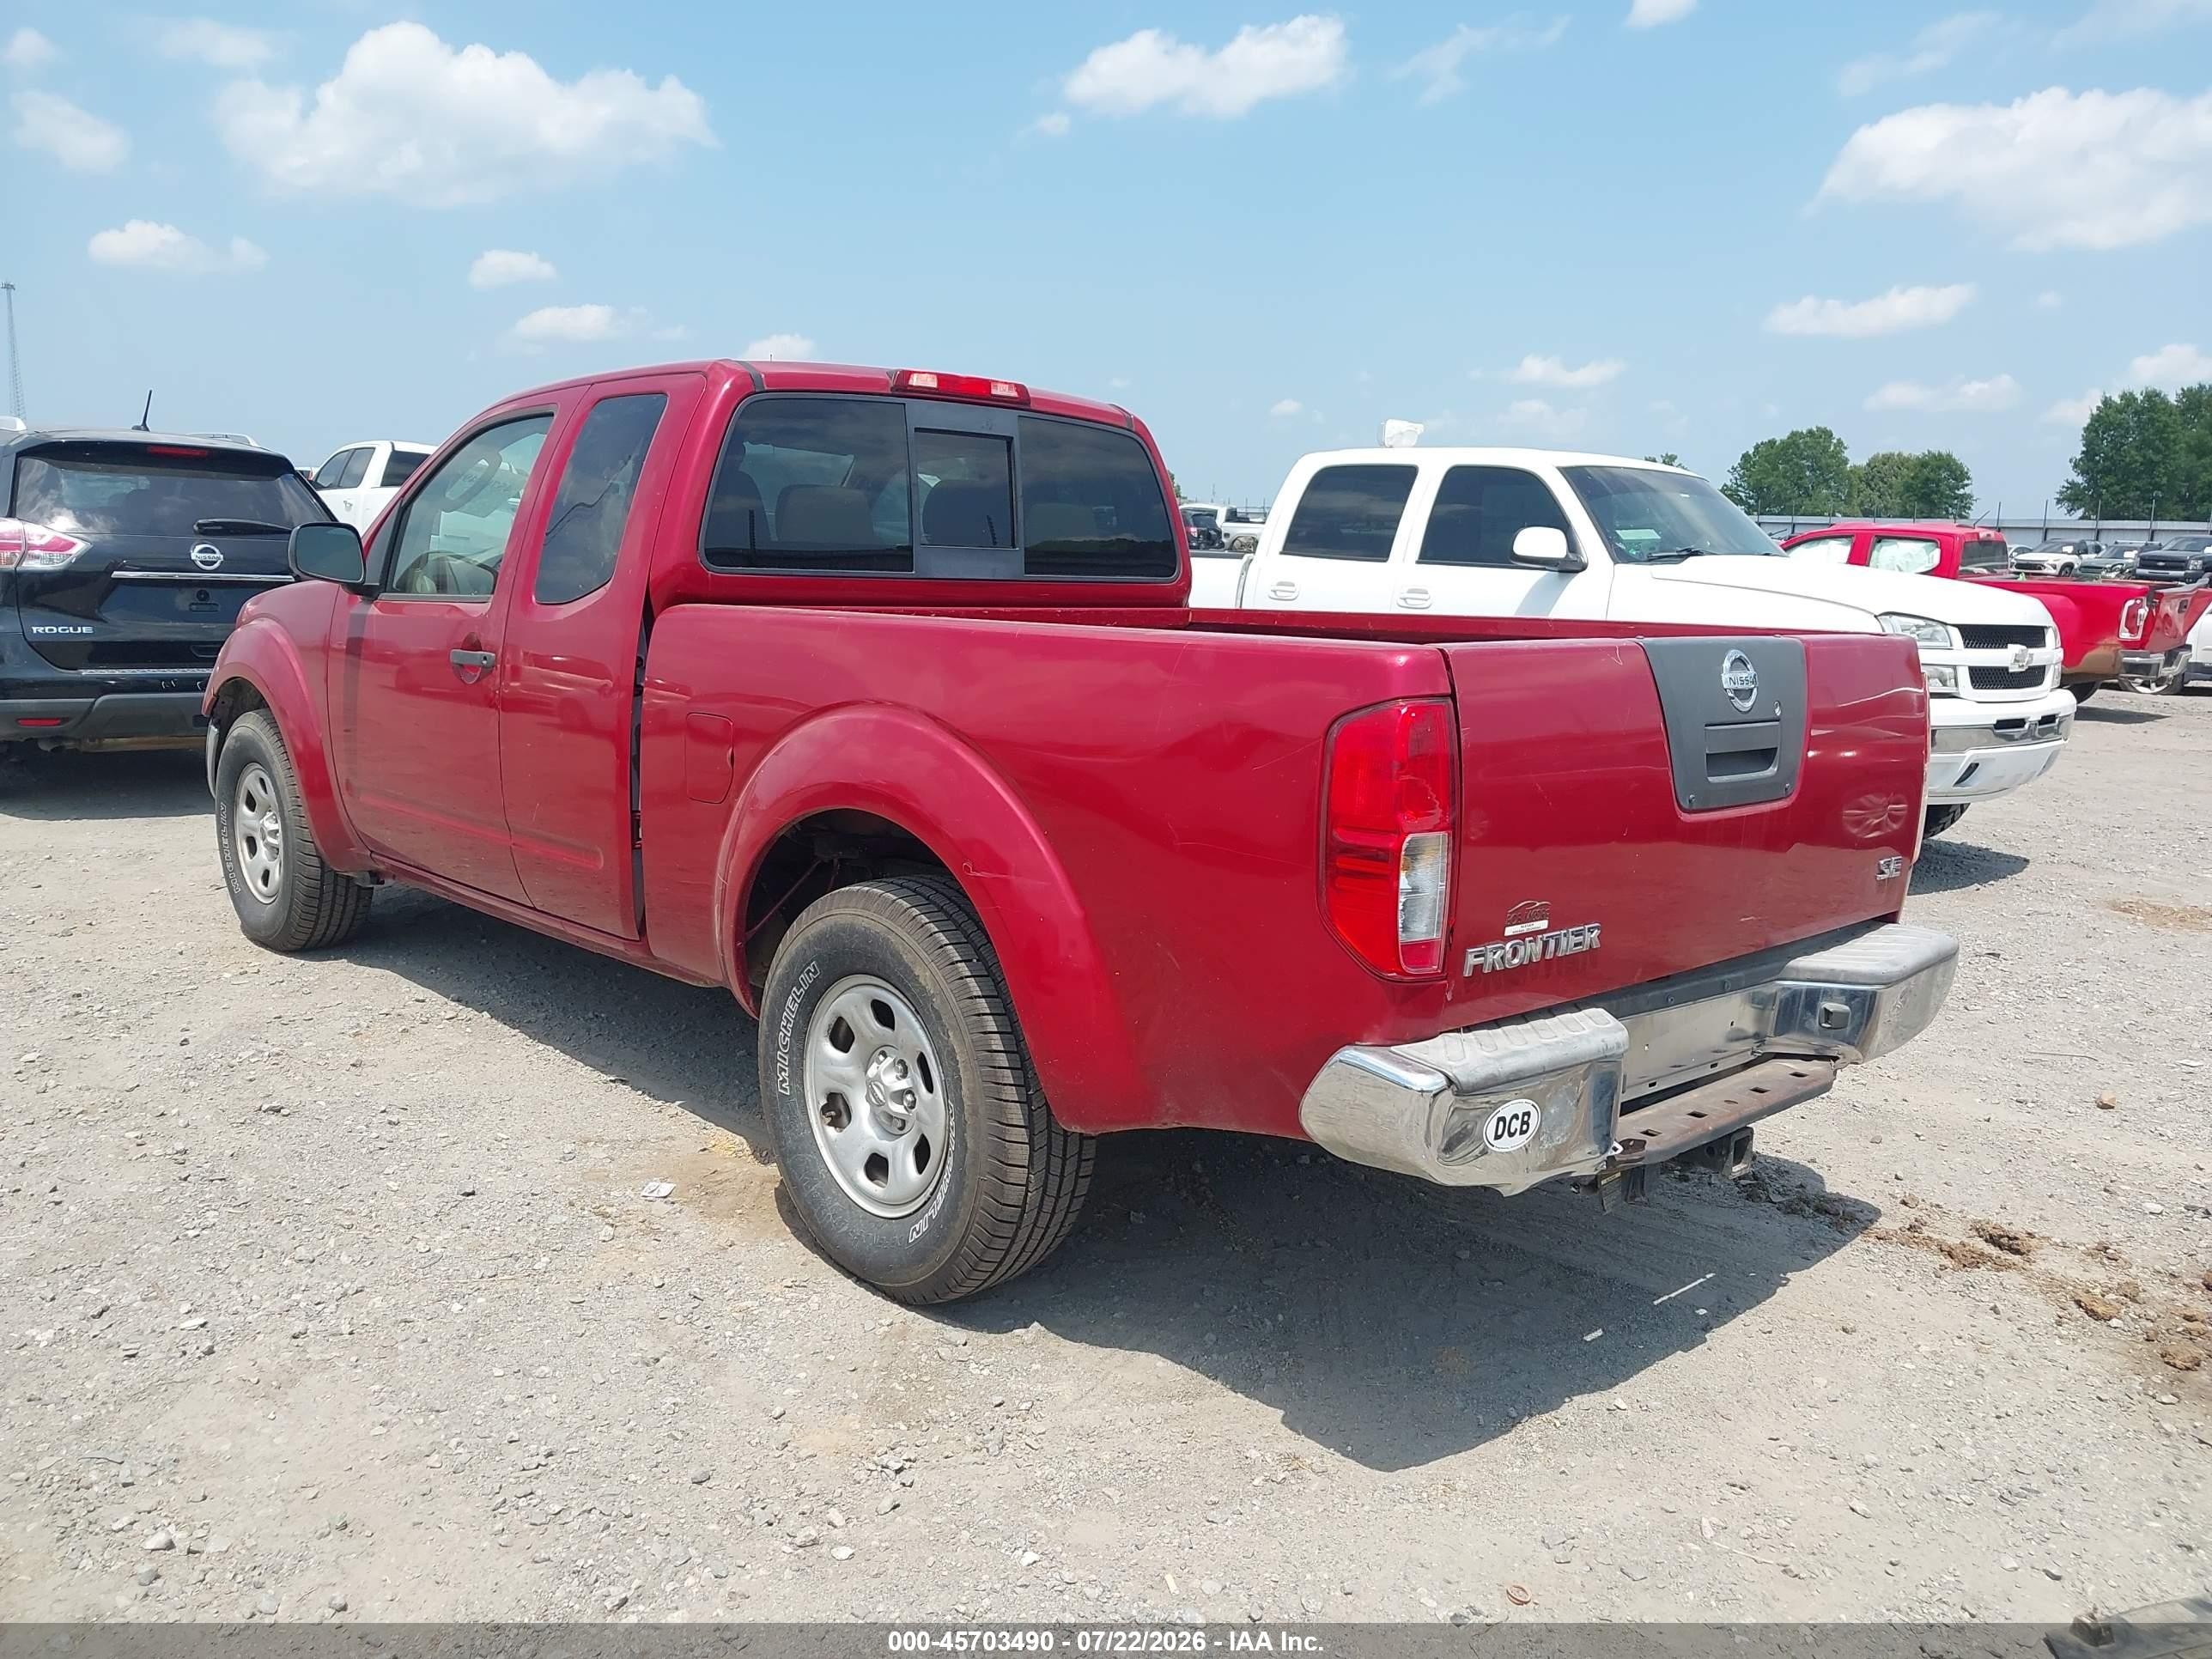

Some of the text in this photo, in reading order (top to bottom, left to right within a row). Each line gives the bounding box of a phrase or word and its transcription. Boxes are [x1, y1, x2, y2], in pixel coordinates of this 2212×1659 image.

[220, 801, 242, 894] MICHELIN
[1876, 856, 1902, 880] SE
[1463, 922, 1601, 977] FRONTIER
[777, 961, 821, 1096] MICHELIN
[1493, 1110, 1531, 1141] DCB
[908, 1099, 956, 1243] MICHELIN
